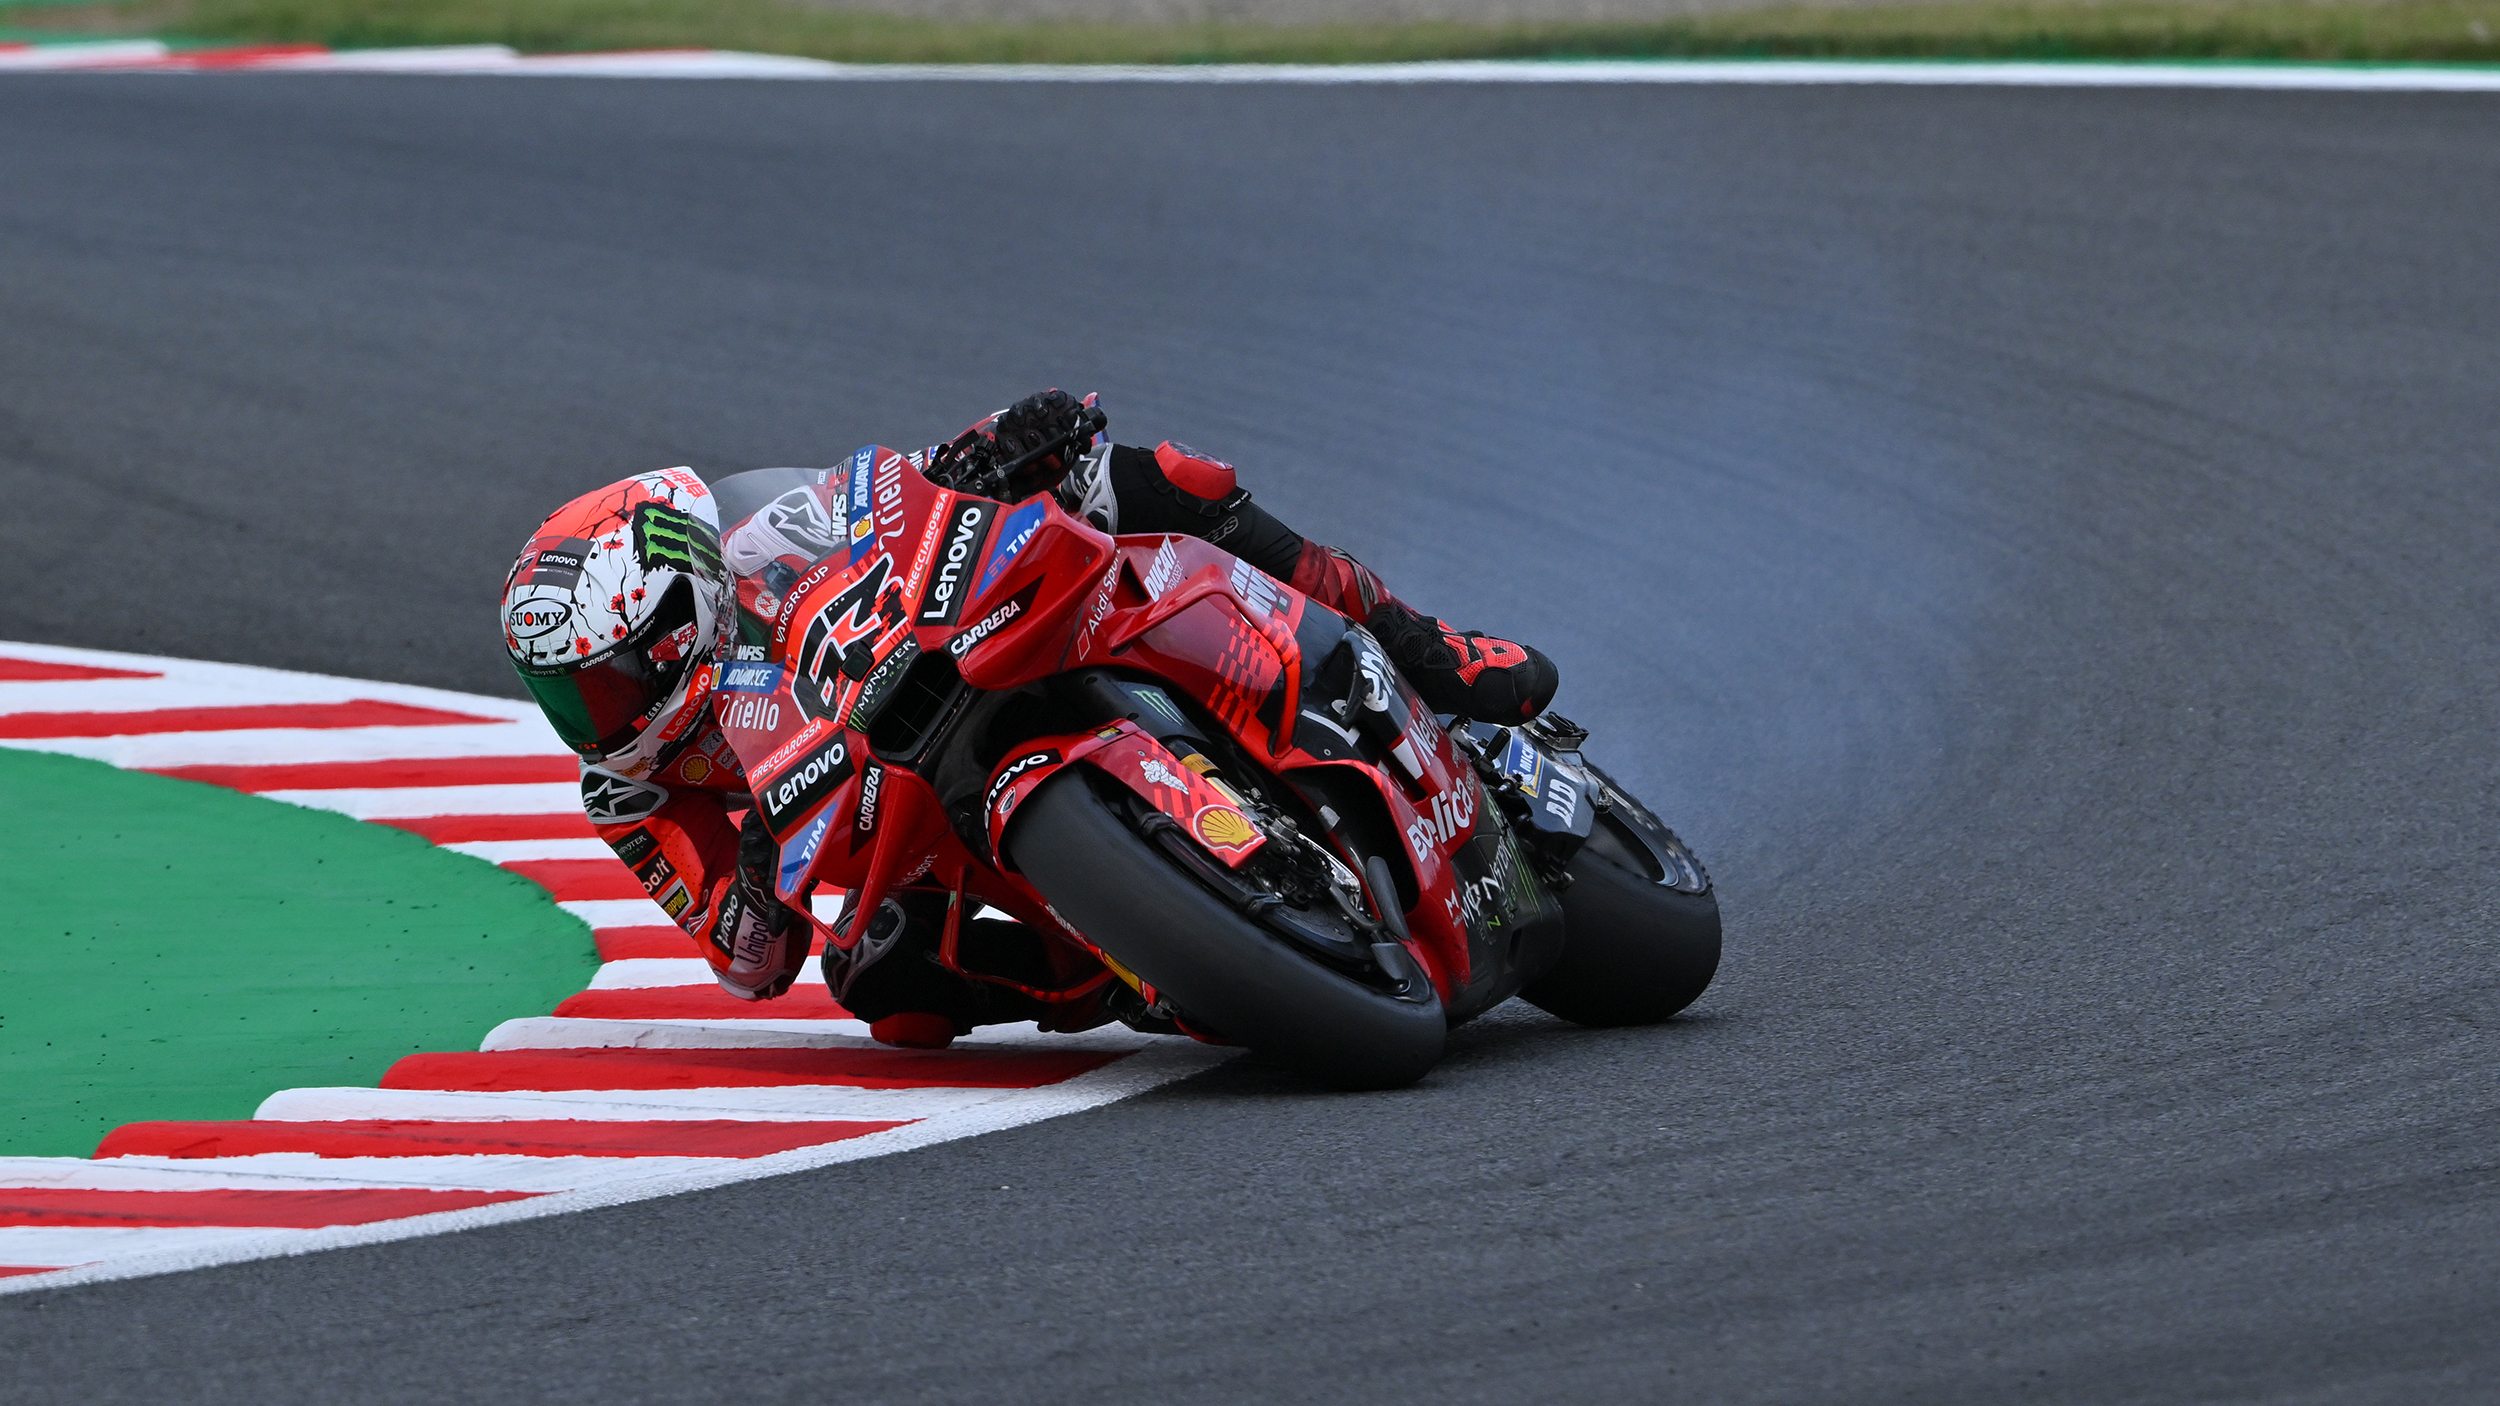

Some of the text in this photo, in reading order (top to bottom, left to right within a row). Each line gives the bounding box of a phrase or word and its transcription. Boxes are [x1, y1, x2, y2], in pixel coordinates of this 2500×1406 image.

[854, 450, 873, 509] ADVANCE
[832, 494, 848, 536] WRS
[1006, 518, 1042, 554] TIM
[540, 553, 578, 567] Lenovo
[904, 492, 948, 599] FRECCIAROSSA
[923, 507, 982, 618] Lenovo
[1144, 534, 1177, 602] DUCATI
[511, 611, 564, 626] SUOMY
[951, 600, 1021, 655] CARRERA
[1088, 590, 1109, 635] Audi
[580, 649, 615, 669] CARRERA
[724, 667, 772, 687] ADVANCE
[737, 645, 765, 661] WRS
[666, 673, 709, 735] Lenovo
[751, 719, 822, 783] FRECCIAROSSA
[766, 743, 845, 817] Lenovo
[859, 766, 882, 831] CARRERA
[801, 818, 826, 863] TIM
